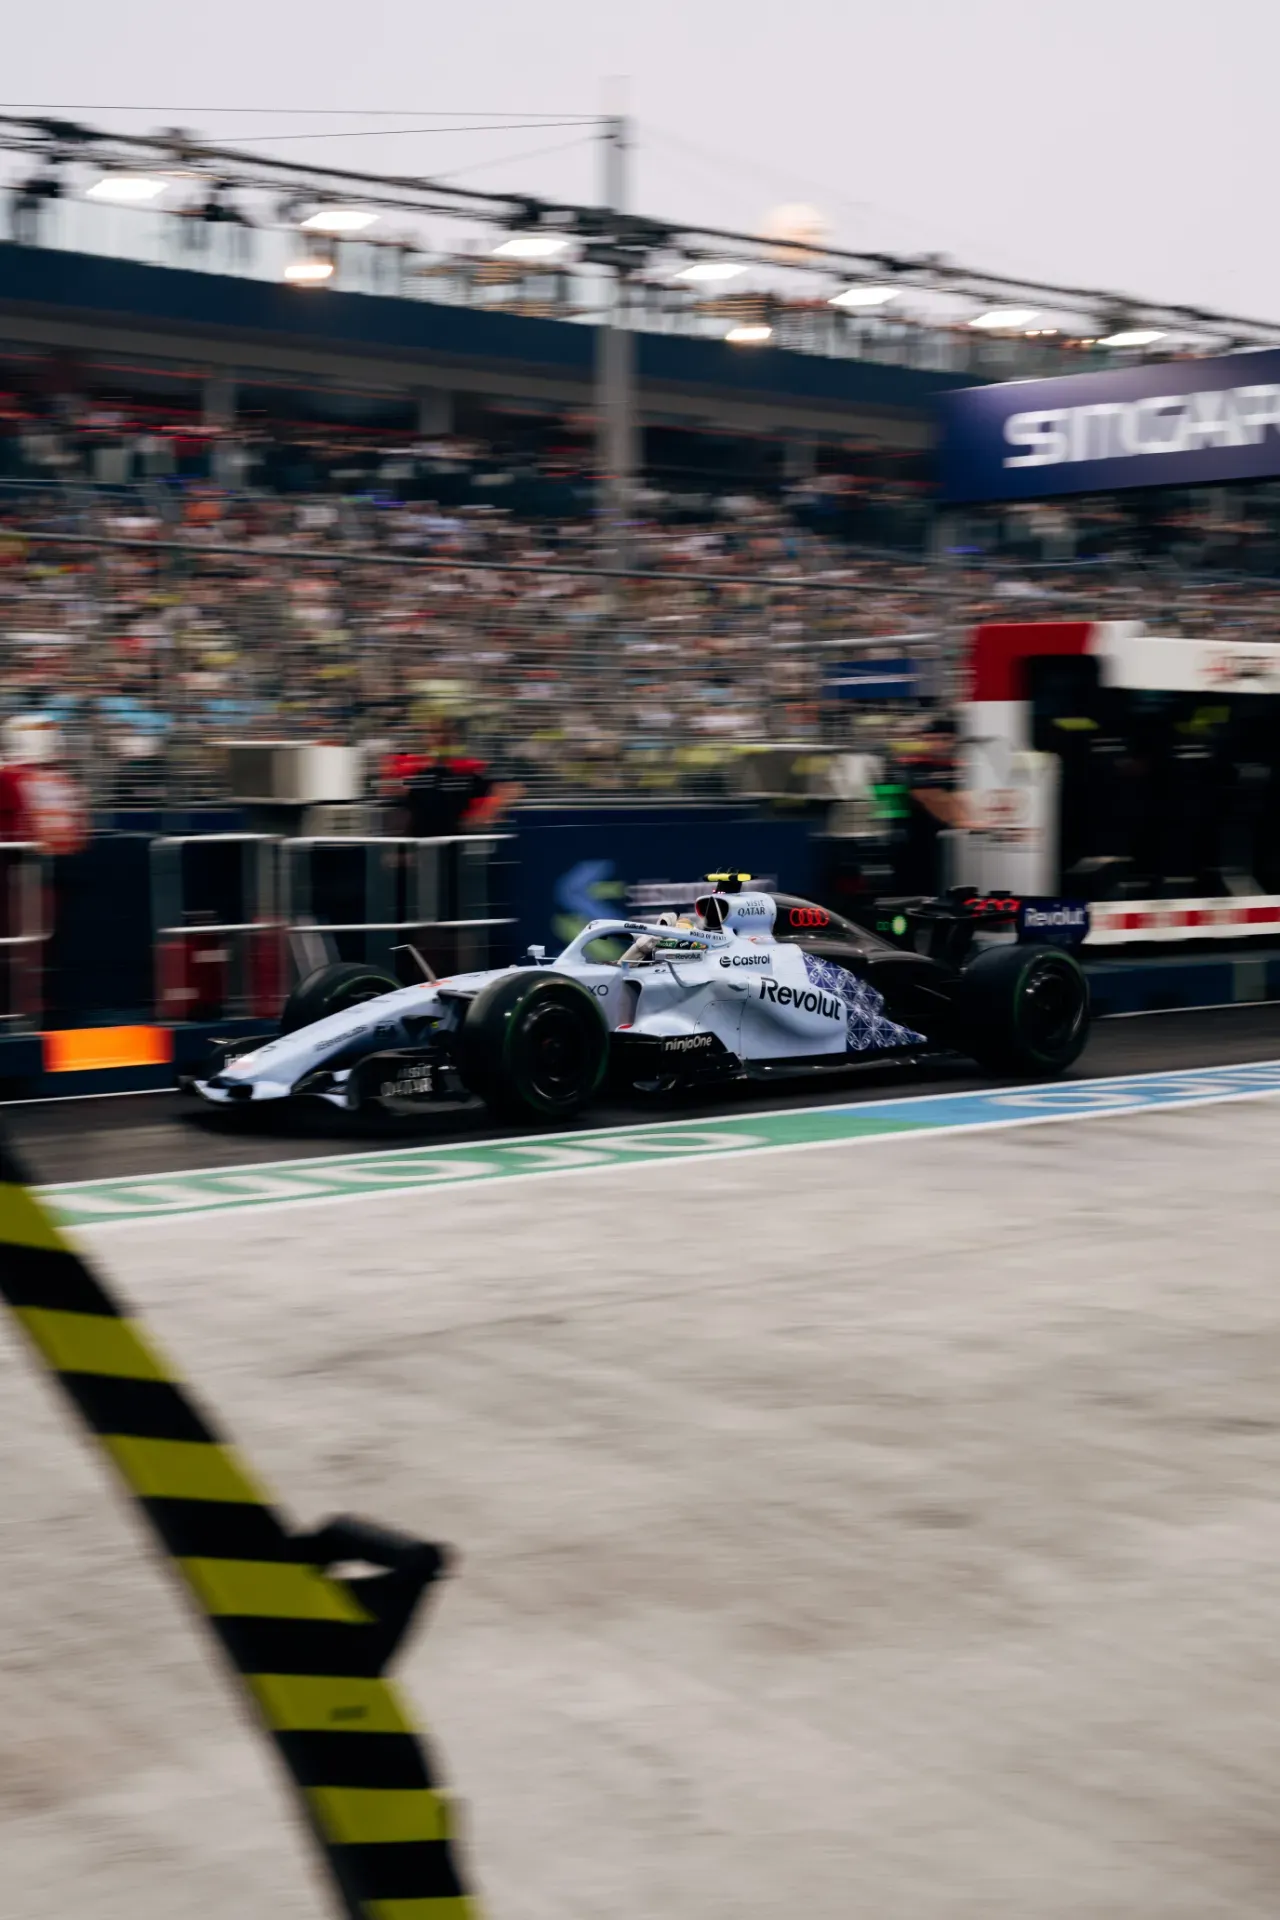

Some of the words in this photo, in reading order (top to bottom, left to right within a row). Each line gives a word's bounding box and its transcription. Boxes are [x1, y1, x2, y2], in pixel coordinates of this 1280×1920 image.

[737, 907, 766, 916] QATAR
[1023, 906, 1085, 927] Revolut
[624, 922, 648, 931] Gillette
[732, 953, 770, 967] Castrol
[759, 976, 842, 1021] Revolut
[665, 1035, 712, 1052] ninjaOne
